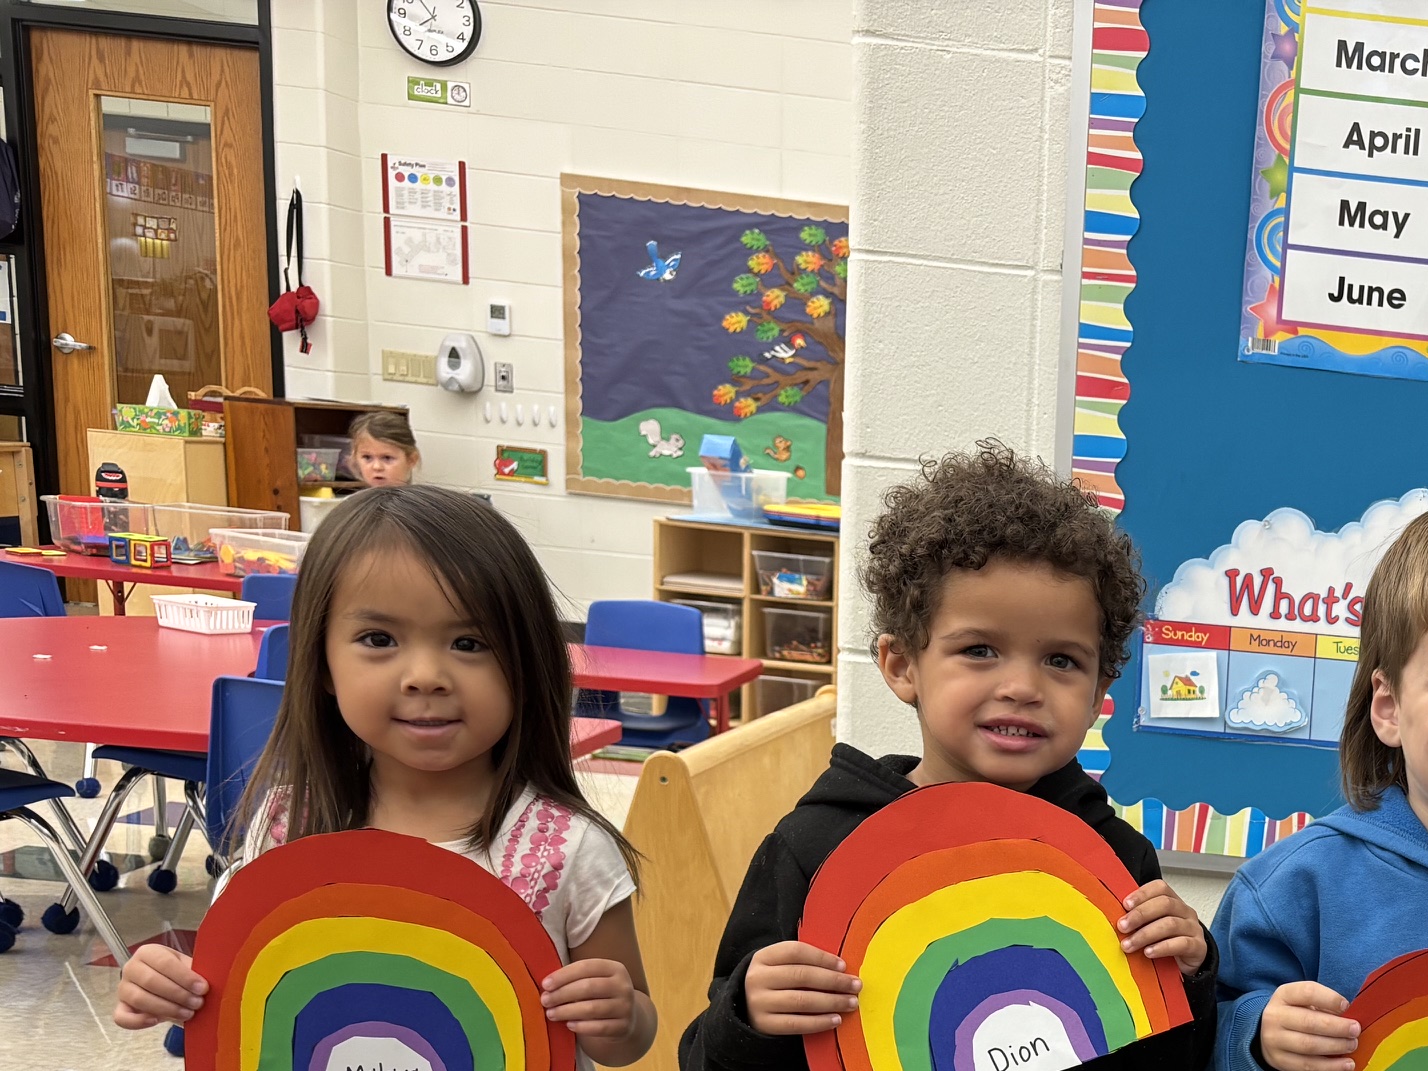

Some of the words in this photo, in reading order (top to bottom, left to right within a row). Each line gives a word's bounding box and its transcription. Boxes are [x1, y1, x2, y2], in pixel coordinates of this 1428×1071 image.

[456, 0, 464, 9] 2
[397, 8, 406, 18] 9
[462, 15, 471, 27] 3
[403, 25, 412, 36] 8
[456, 32, 466, 43] 4
[415, 39, 424, 50] 7
[446, 42, 454, 53] 5
[429, 45, 438, 56] 6
[415, 81, 440, 95] clock
[1342, 121, 1421, 158] April
[1338, 199, 1411, 239] May
[1327, 276, 1407, 310] June
[1225, 567, 1364, 627] What's
[1161, 625, 1210, 645] Sunday
[1249, 633, 1297, 653] Monday
[1333, 641, 1359, 656] Tues
